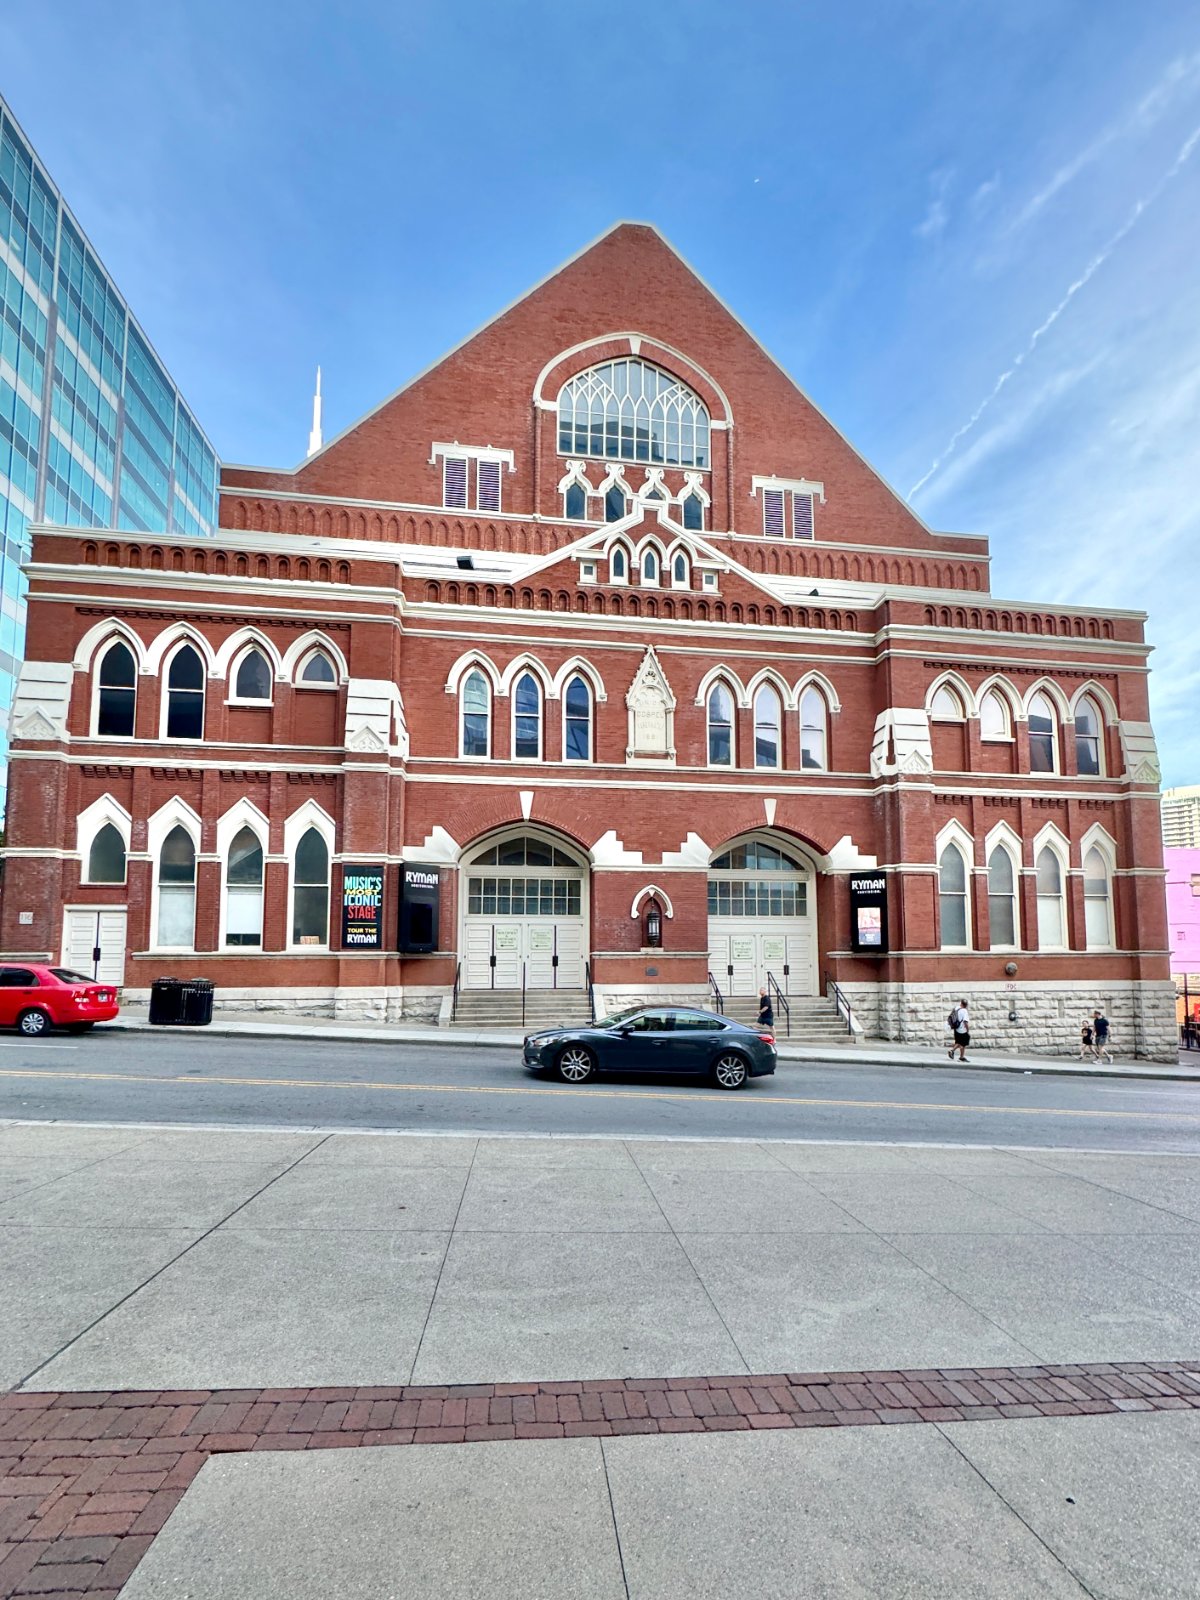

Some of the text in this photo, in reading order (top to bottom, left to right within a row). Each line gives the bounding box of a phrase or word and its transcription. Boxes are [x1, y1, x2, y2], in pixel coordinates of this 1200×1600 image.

[344, 876, 382, 890] MUSIC'S
[405, 871, 439, 885] RYMAN
[851, 879, 886, 890] RYMAN
[344, 895, 382, 906] ICONIC
[347, 906, 376, 919] STAGE
[346, 934, 377, 944] RYMAN
